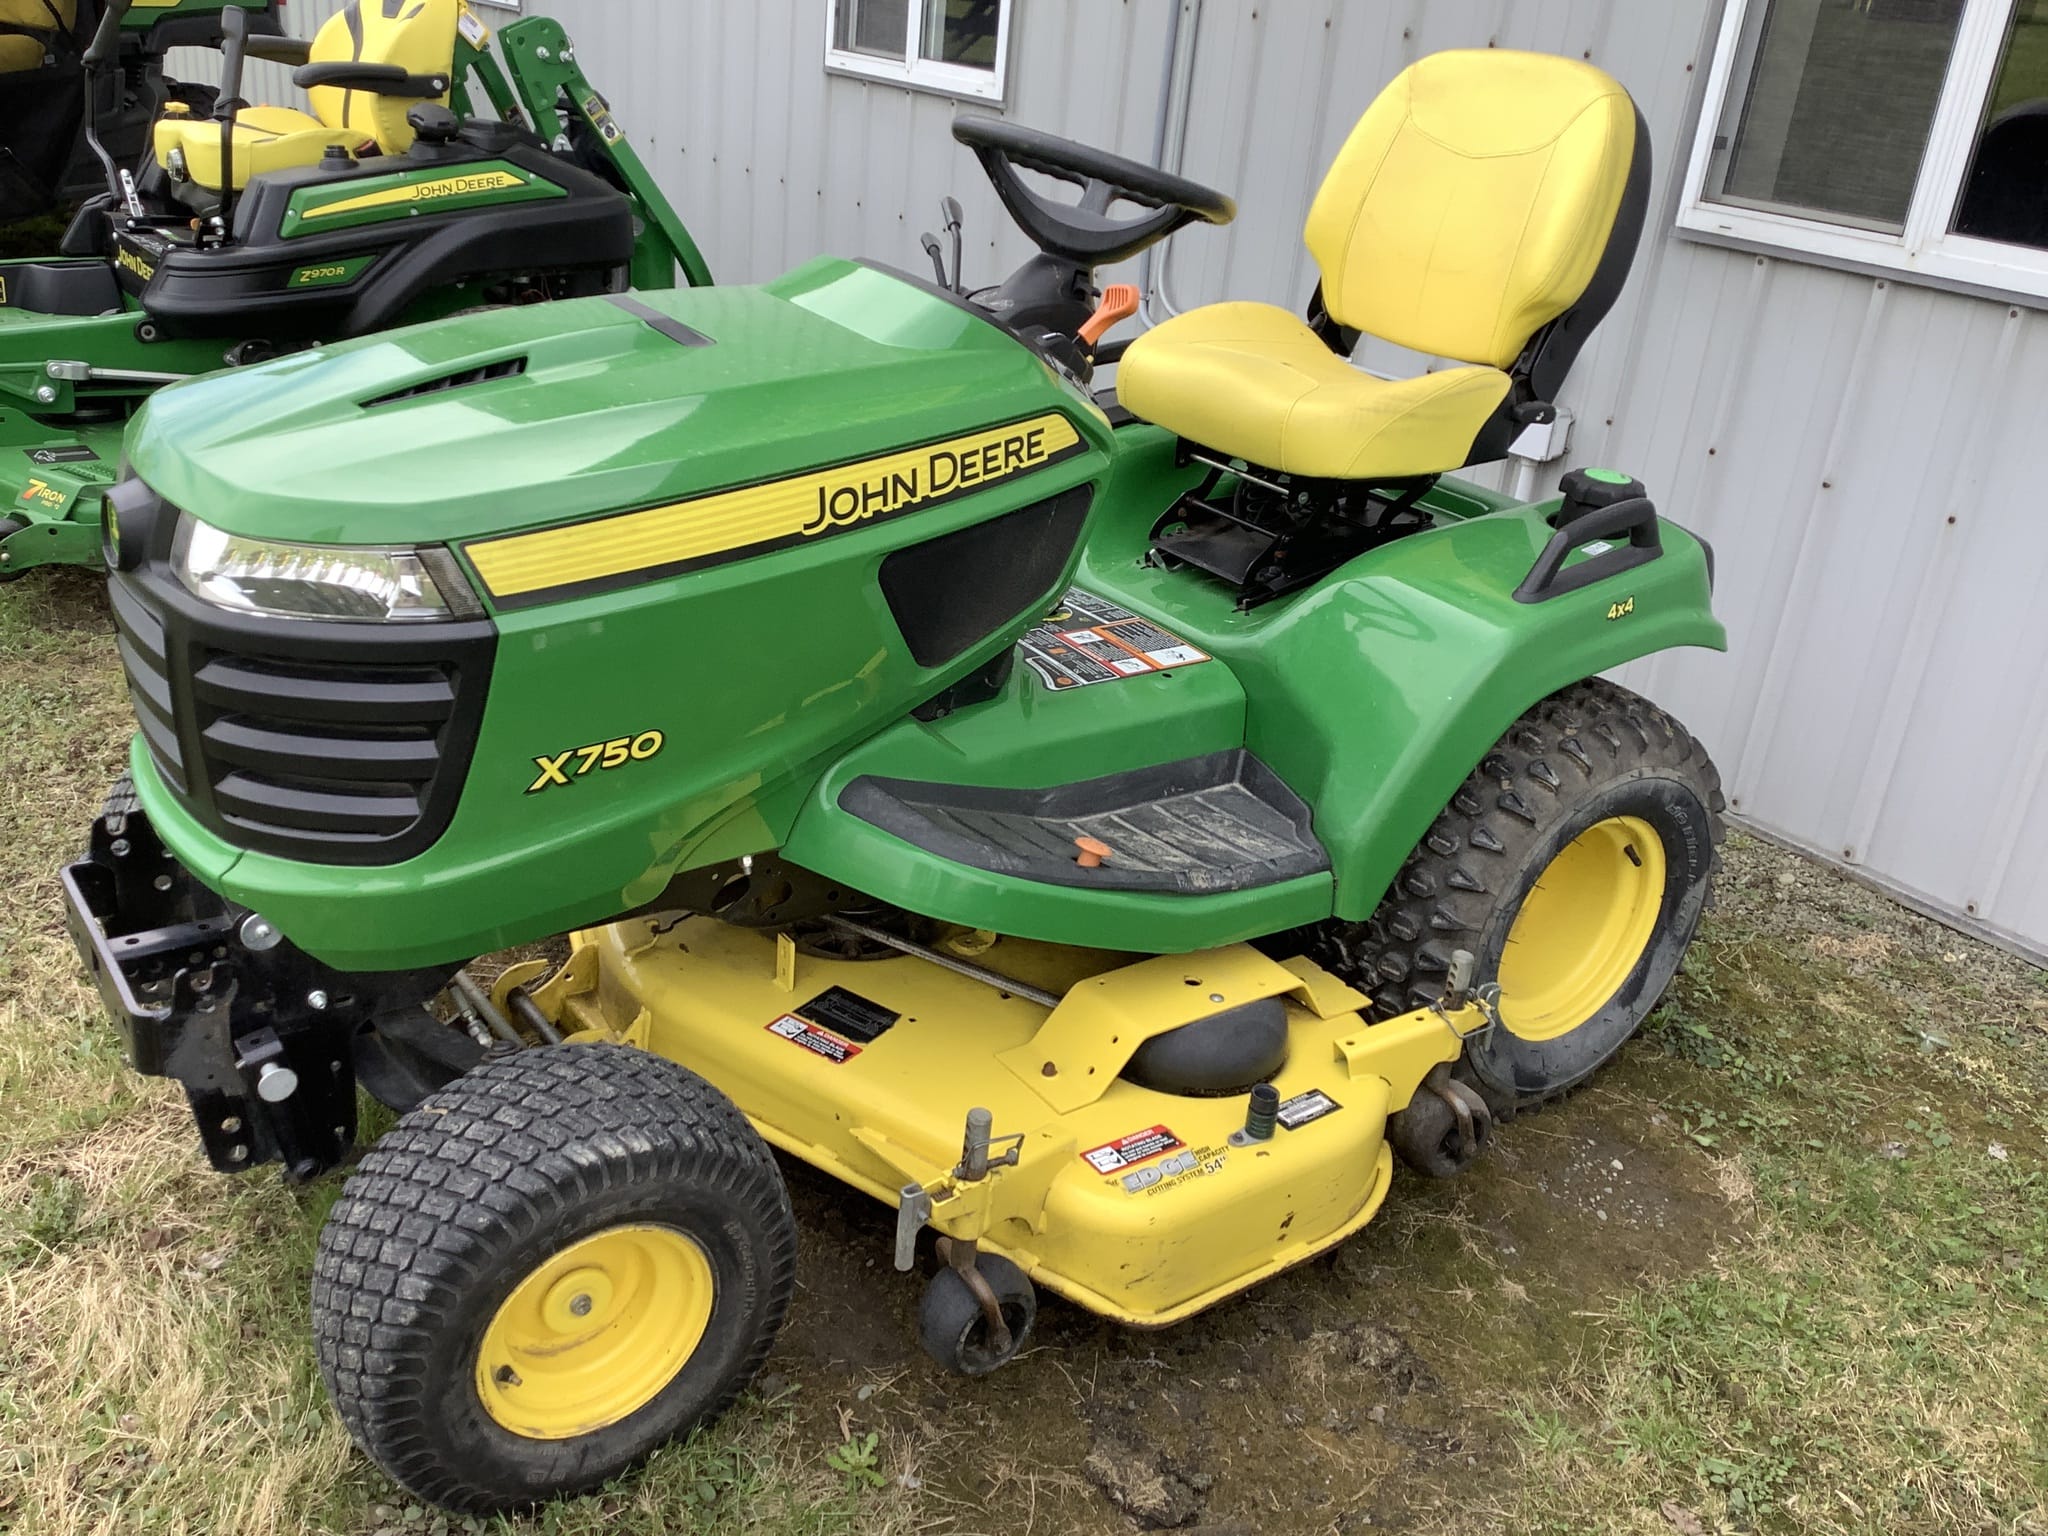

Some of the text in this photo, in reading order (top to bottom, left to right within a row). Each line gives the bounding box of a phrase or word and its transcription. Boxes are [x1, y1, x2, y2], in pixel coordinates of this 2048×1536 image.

[411, 176, 504, 199] JOHN DEERE
[117, 244, 138, 273] JOHN
[299, 266, 345, 283] Z970R
[22, 478, 67, 504] 7 IRON
[802, 426, 1046, 532] JOHN DEERE
[1607, 596, 1634, 620] 4x4
[523, 728, 664, 794] X750
[1198, 1146, 1229, 1161] CAPACITY
[1121, 1150, 1200, 1193] EDGE
[1146, 1178, 1178, 1197] CUTTING
[1176, 1167, 1206, 1184] SYSTEM
